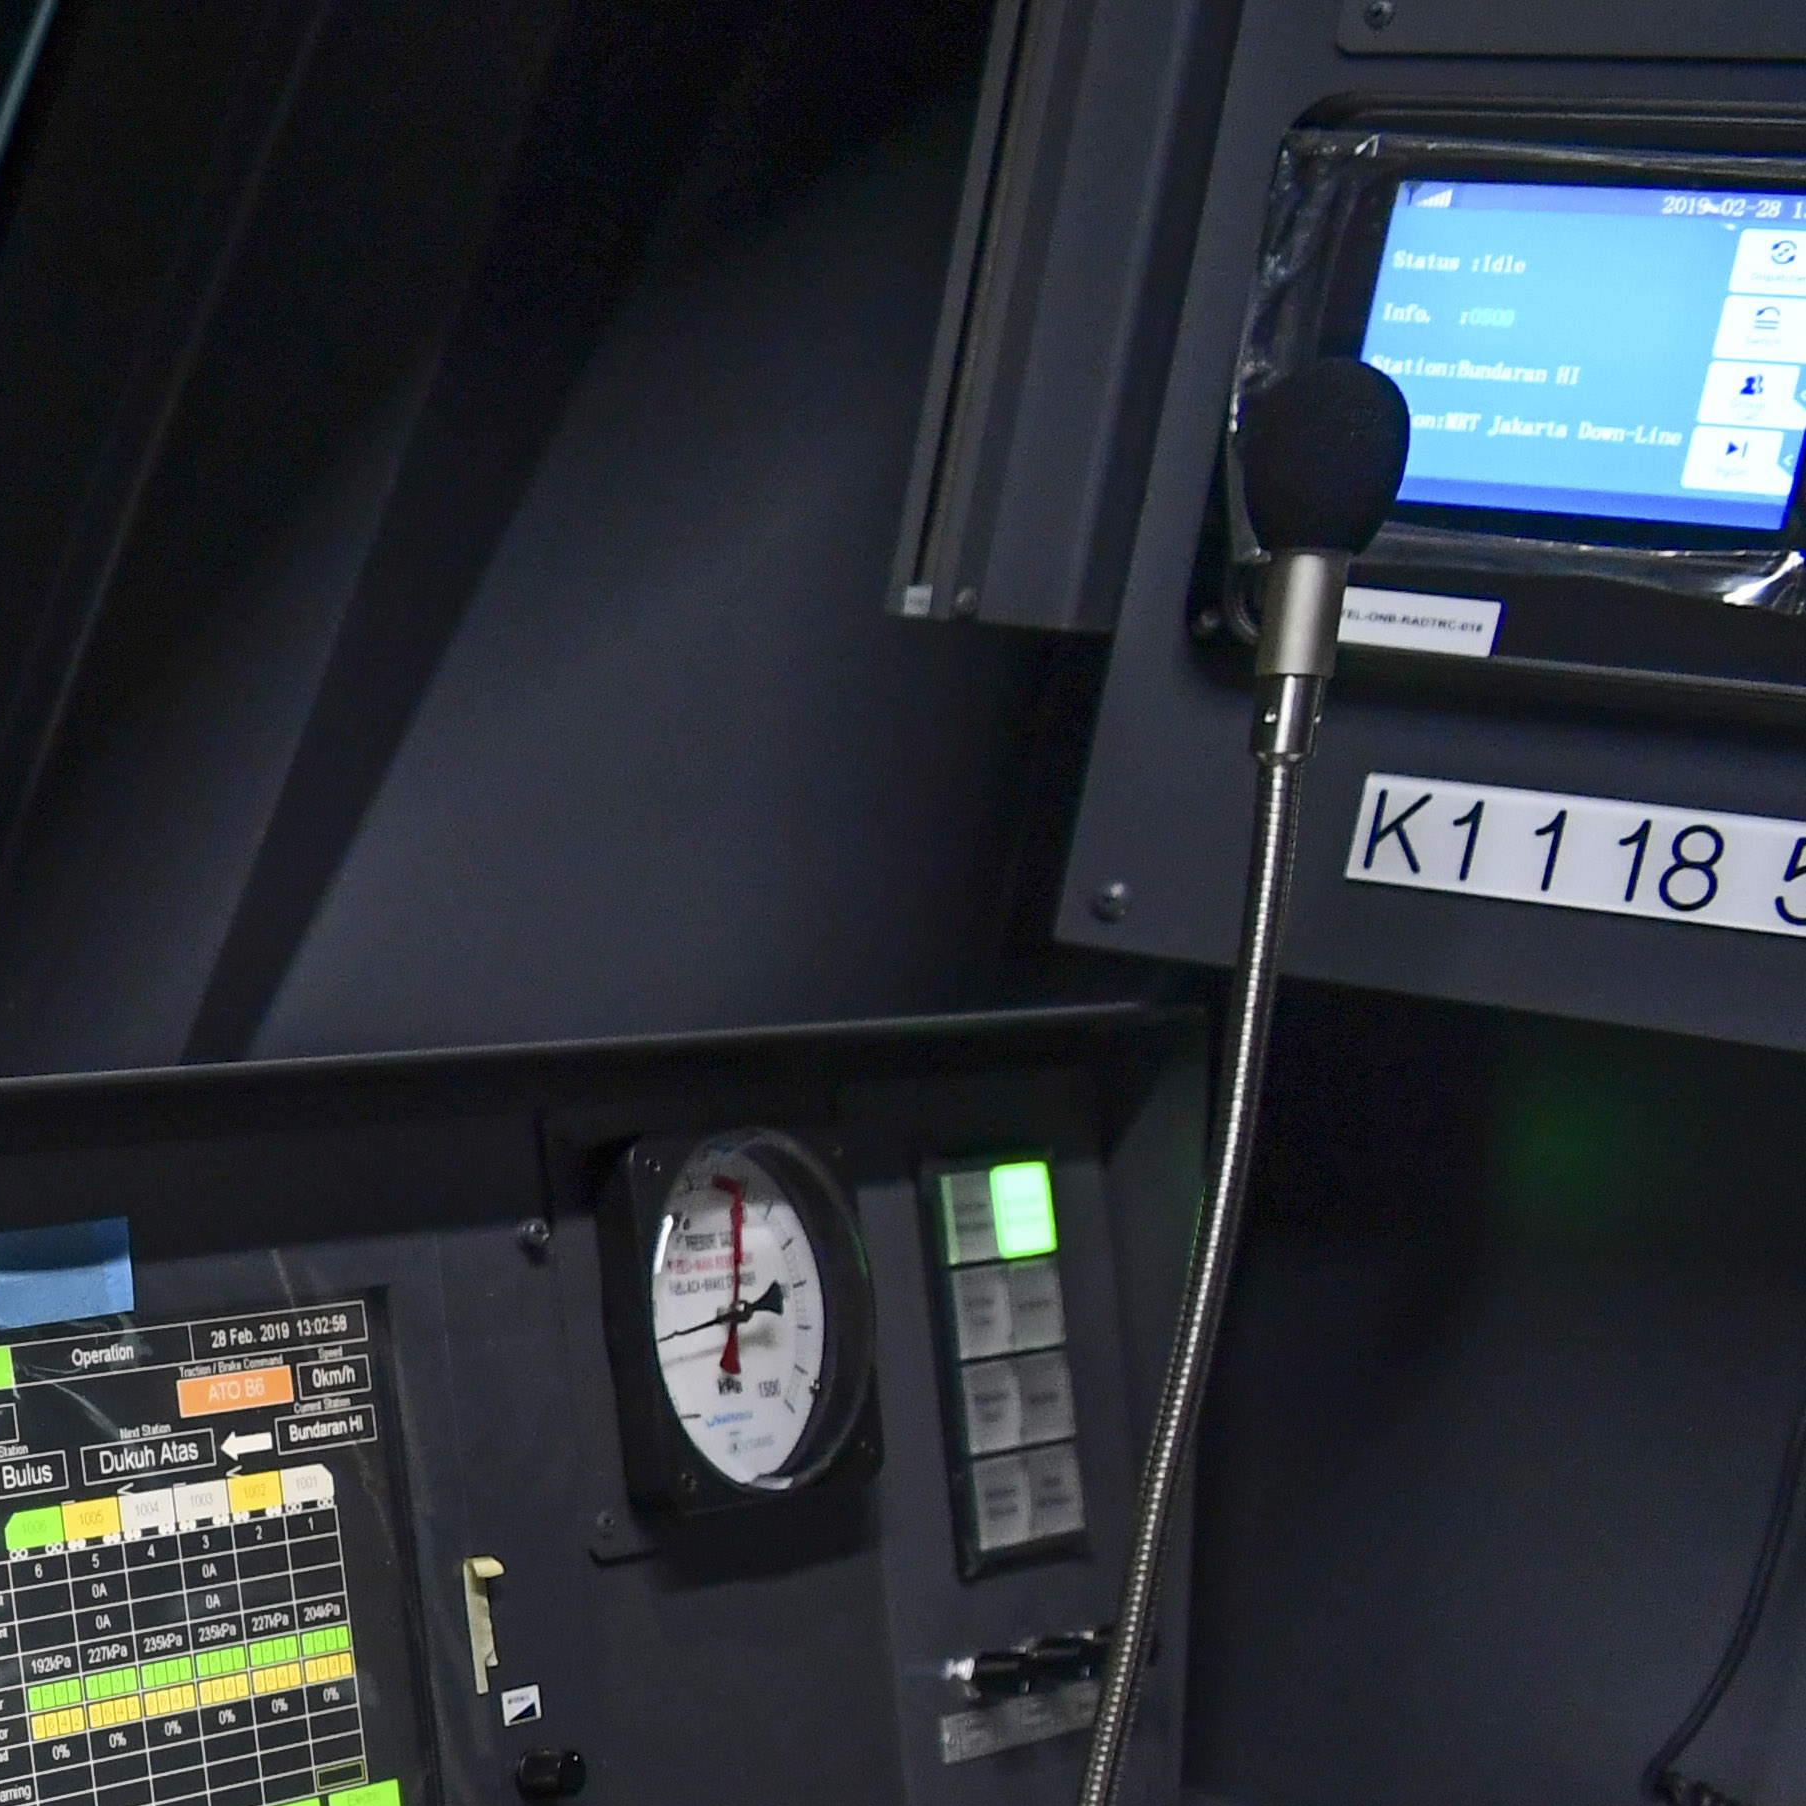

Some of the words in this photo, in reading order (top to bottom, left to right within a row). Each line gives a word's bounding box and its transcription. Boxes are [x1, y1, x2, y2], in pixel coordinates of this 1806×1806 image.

[1393, 251, 1459, 272] Status
[1556, 366, 1581, 385] HI
[1488, 415, 1567, 439] Jakarta
[210, 1329, 227, 1349] 28
[229, 1327, 257, 1346] Feb.
[71, 1343, 135, 1369] Operation
[312, 1364, 356, 1388] 0km/h
[208, 1380, 241, 1402] ATO
[244, 1376, 265, 1398] B6
[288, 1420, 348, 1442] Bundaran
[348, 1415, 364, 1432] HI
[99, 1445, 156, 1474] Dukuh
[160, 1441, 199, 1465] Atas
[1, 1462, 53, 1490] Bulus
[255, 1524, 263, 1541] 2
[308, 1516, 314, 1531] 1
[147, 1544, 155, 1558] 4
[202, 1534, 210, 1549] 3
[34, 1563, 43, 1578] 6
[91, 1552, 100, 1569] 5
[201, 1563, 218, 1579] 0A
[91, 1582, 108, 1599] 0A
[205, 1593, 221, 1609] 0A
[95, 1614, 112, 1630] 0A
[251, 1612, 290, 1632] 227kPa
[303, 1602, 341, 1622] 204kPa
[143, 1632, 183, 1653] 235kPa
[198, 1622, 237, 1643] 235kPa
[87, 1643, 128, 1664] 227kPa
[31, 1654, 72, 1674] 192kPa
[51, 1743, 71, 1761] 0%
